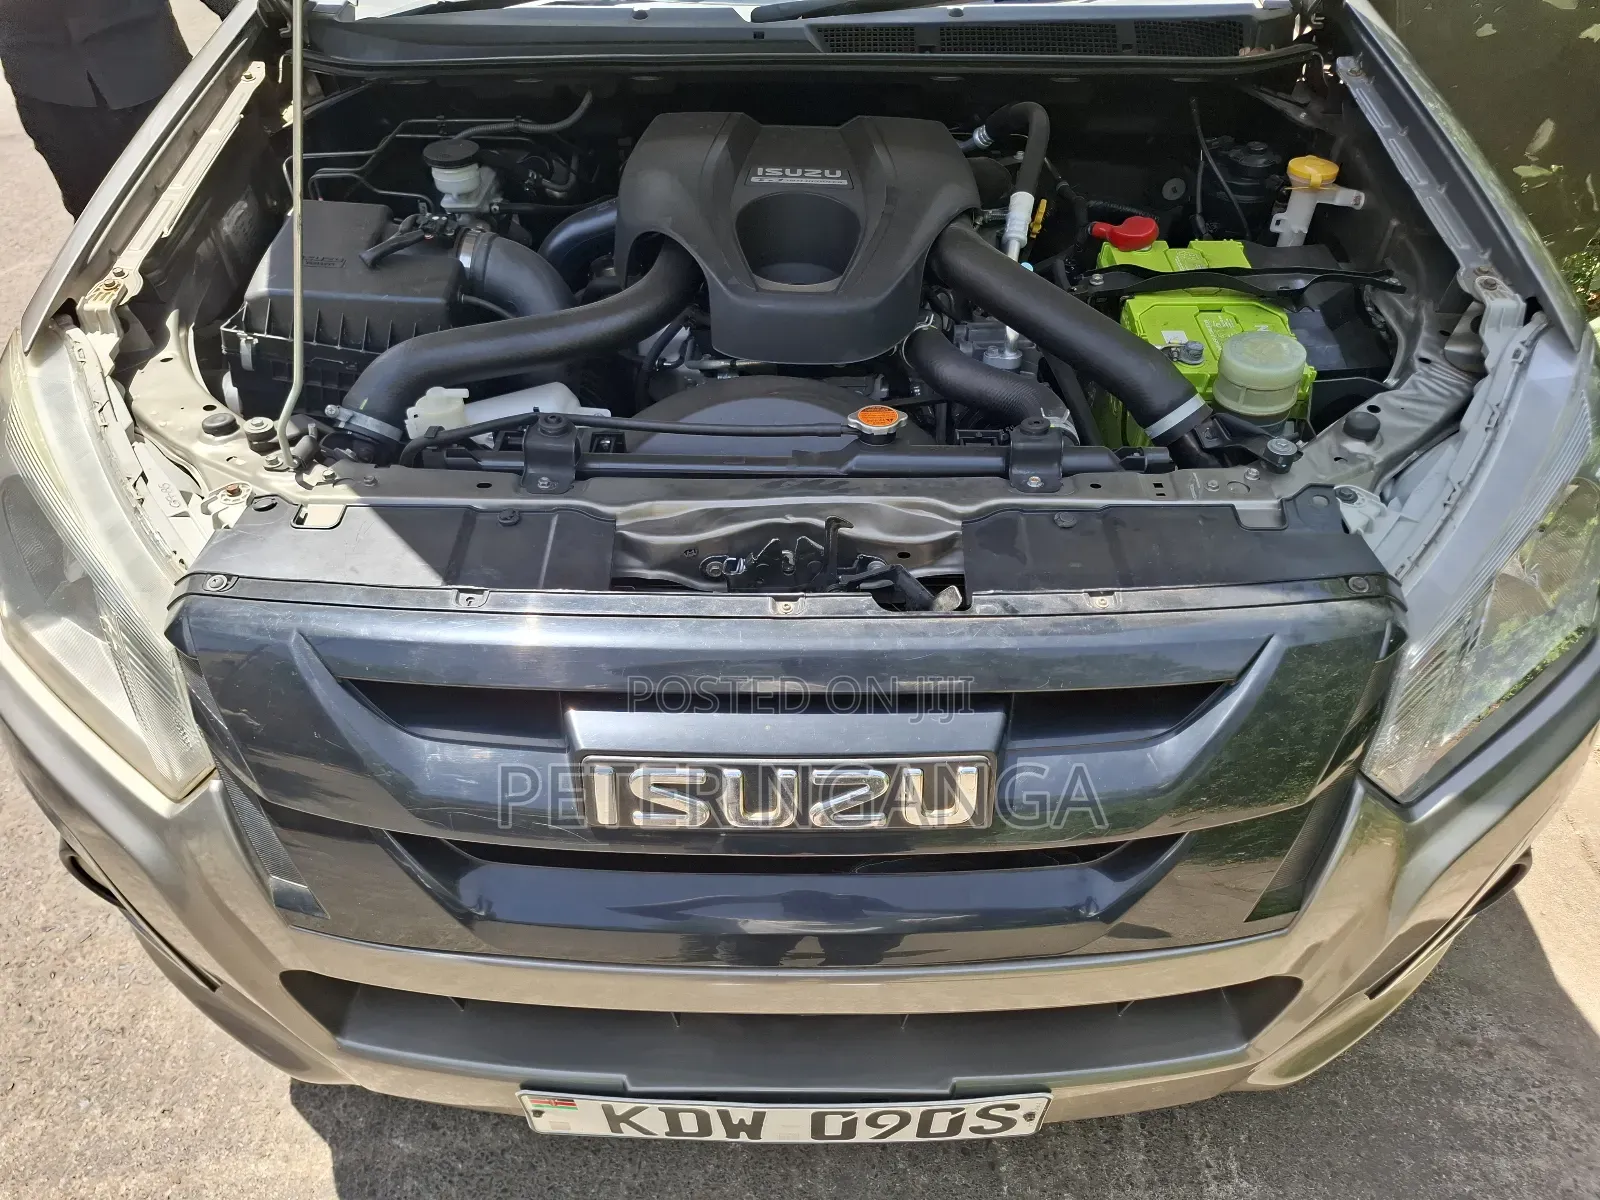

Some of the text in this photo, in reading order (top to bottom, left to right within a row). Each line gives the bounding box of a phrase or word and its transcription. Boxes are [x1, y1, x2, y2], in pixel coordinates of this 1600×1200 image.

[757, 167, 842, 178] ISUZU
[593, 765, 978, 829] ISUZU
[600, 1103, 767, 1141] KDW
[810, 1102, 1021, 1141] 090S
